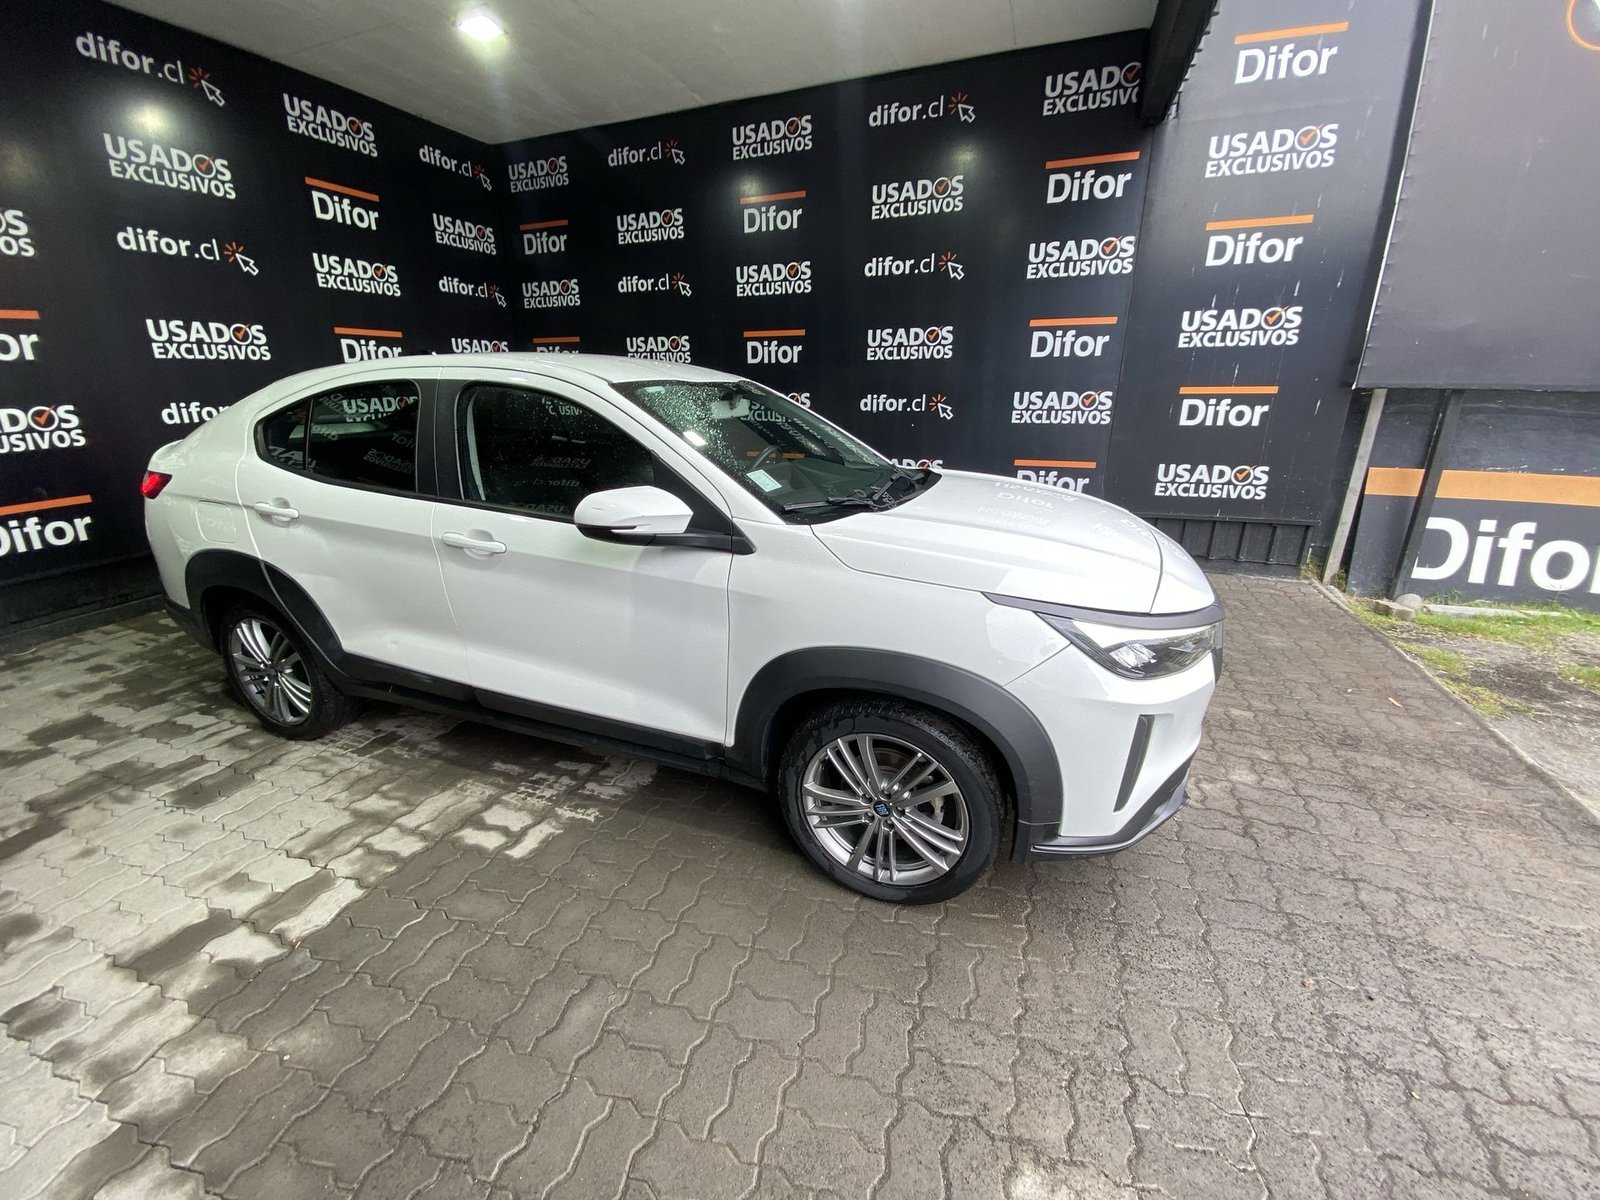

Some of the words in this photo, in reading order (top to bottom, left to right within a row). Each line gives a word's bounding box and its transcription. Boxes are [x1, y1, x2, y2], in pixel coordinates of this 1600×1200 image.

[76, 32, 185, 84] difor.cl
[1234, 43, 1338, 85] Difor
[1045, 62, 1142, 97] USADO
[869, 95, 944, 127] difor.cl
[1043, 87, 1140, 116] EXCLUSIV
[283, 93, 374, 142] USADOS
[732, 115, 812, 145] USADOS
[287, 116, 378, 158] EXCLUSIVOS
[732, 135, 813, 160] EXCLUSIVOS
[1209, 124, 1339, 159] USADOS
[103, 133, 232, 182] USADOS
[419, 145, 472, 178] difor.cl
[608, 141, 662, 167] difor.cl
[1205, 149, 1336, 179] EXCLUSIVOS
[108, 158, 236, 200] EXCLUSIVOS
[508, 156, 567, 181] USADOS
[510, 173, 569, 193] EXCLUSIVOS
[872, 175, 964, 204] USADOS
[1047, 169, 1132, 204] Difor
[311, 190, 379, 231] Difor
[617, 208, 683, 232] USADOS
[743, 206, 803, 234] Difor
[871, 197, 964, 220] EXCLUSIVOS
[432, 213, 495, 244] USADOS
[618, 226, 685, 245] EXCLUSIVOS
[117, 226, 220, 262] difor.cl
[435, 231, 496, 255] EXCLUSIVOS
[523, 232, 567, 255] Difor
[1028, 235, 1136, 264] USADOS
[1205, 232, 1303, 267] Difor
[312, 252, 398, 283] USADOS
[736, 260, 811, 284] USADOS
[864, 253, 935, 277] difor.cl
[1026, 257, 1133, 280] EXCLUSIVOS
[316, 273, 401, 297] EXCLUSIVOS
[438, 276, 488, 298] difor.cl
[522, 279, 579, 298] USADOS
[618, 273, 669, 293] difor.cl
[736, 280, 812, 297] EXCLUSIVOS
[524, 294, 580, 309] EXCLUSIVOS
[1181, 306, 1302, 332] USADOS
[146, 319, 267, 346] USADOS
[626, 335, 690, 352] USADOS
[867, 326, 954, 347] USADOS
[1030, 330, 1110, 358] Difor
[1178, 329, 1300, 349] EXCLUSIVOS
[151, 342, 271, 361] EXCLUSIVOS
[341, 338, 402, 363] Difor
[451, 338, 509, 353] USADOS
[747, 341, 802, 364] Difor
[866, 345, 953, 361] EXCLUSIVOS
[161, 401, 230, 425] difo
[860, 394, 926, 413] difor.cl
[1012, 391, 1113, 411] USADOS
[1179, 398, 1269, 427] Difor
[0, 405, 80, 435] DOS
[1011, 410, 1111, 425] EXCLUSIVOS
[0, 429, 87, 454] SIVOS
[1157, 463, 1269, 487] USADOS
[1154, 482, 1266, 500] EXCLUSIVOS
